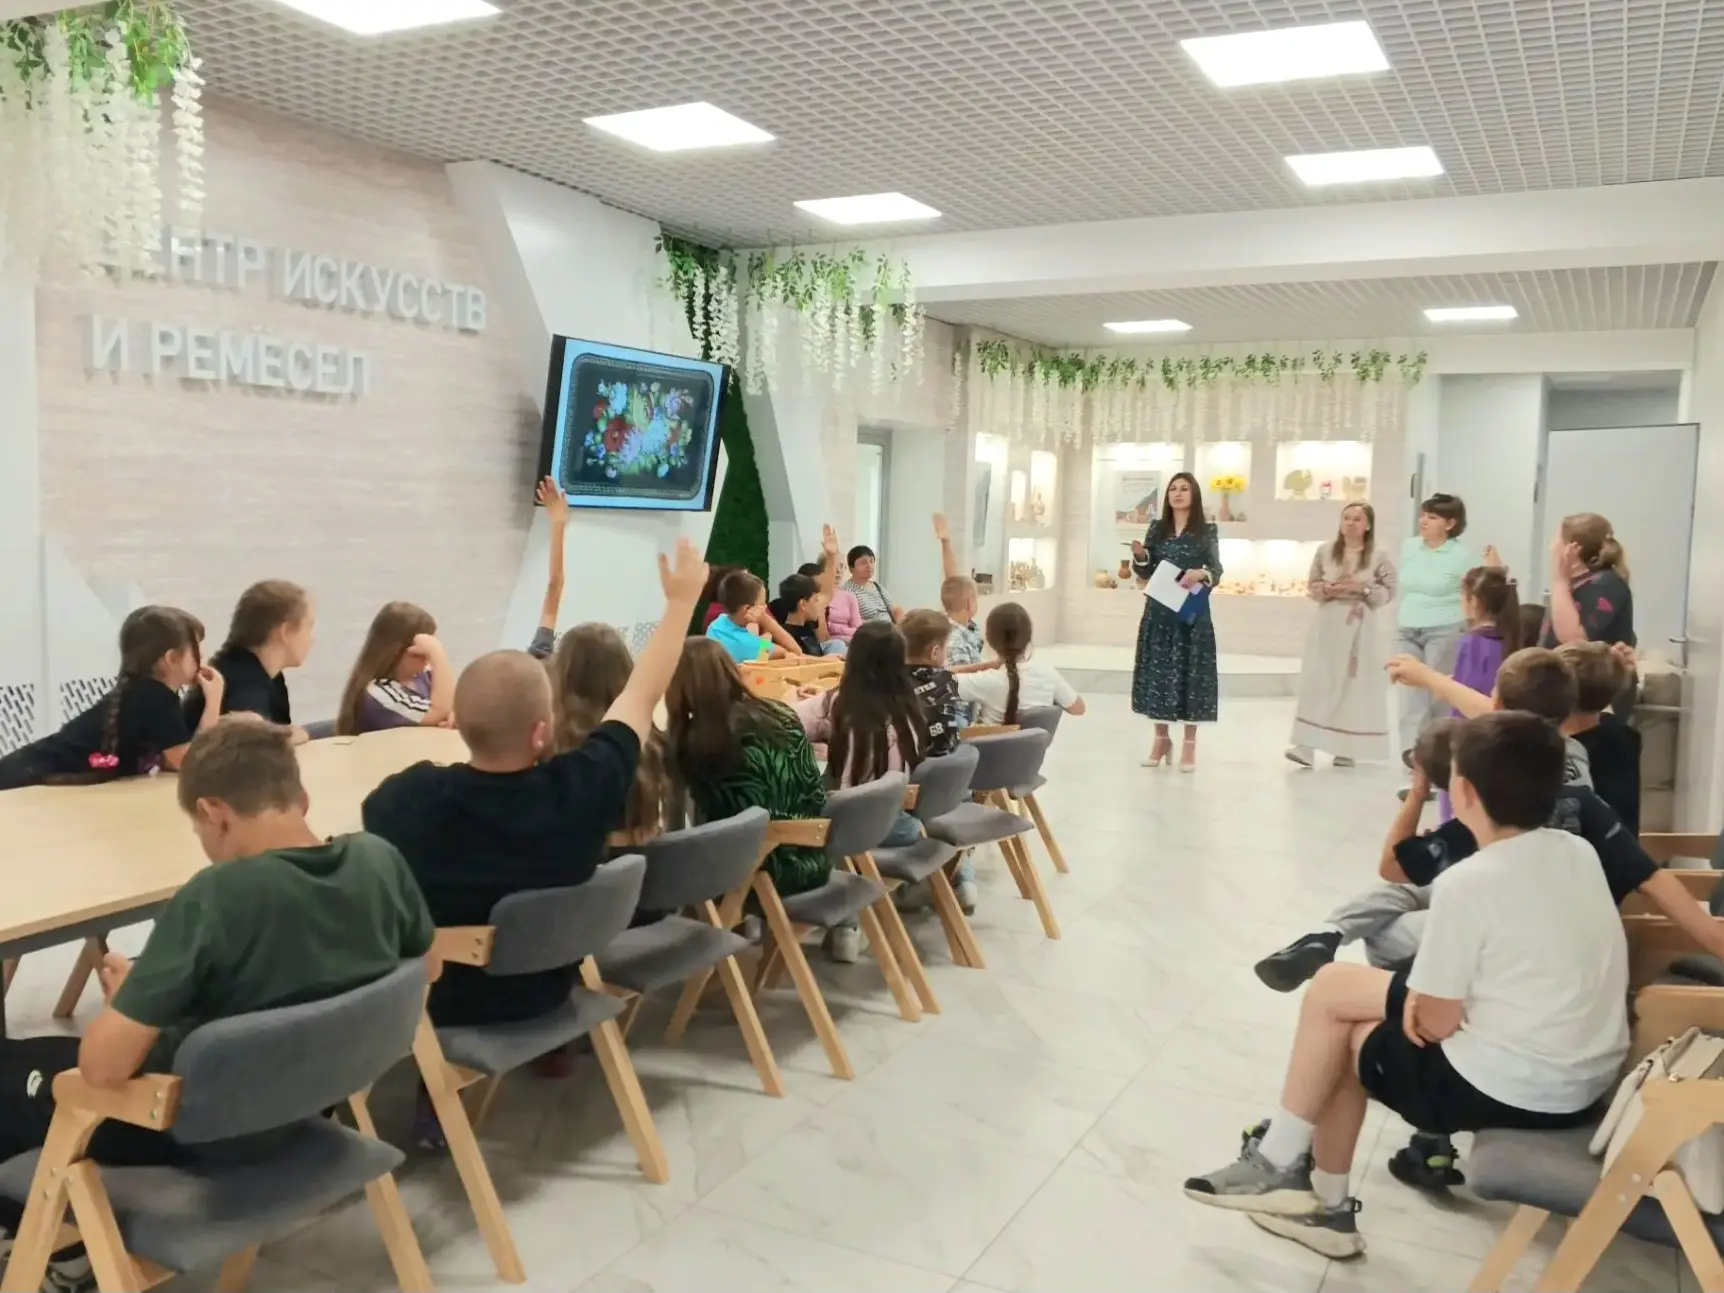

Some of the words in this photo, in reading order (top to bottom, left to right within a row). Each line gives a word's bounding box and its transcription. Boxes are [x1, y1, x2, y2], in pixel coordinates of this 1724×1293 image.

[106, 222, 266, 288] НТР
[283, 248, 487, 330] ИСКУССТВ
[92, 313, 129, 371] И
